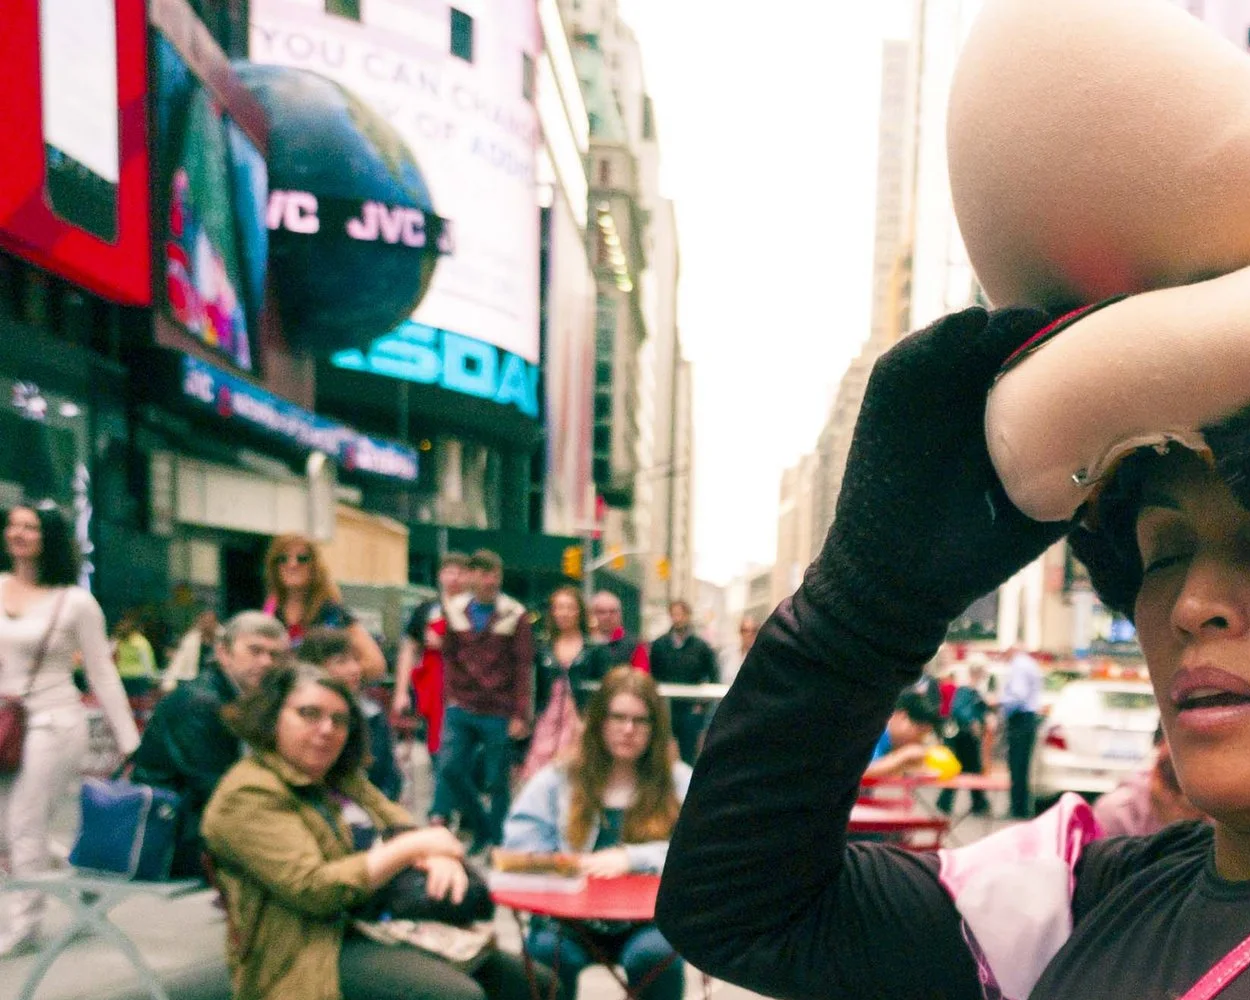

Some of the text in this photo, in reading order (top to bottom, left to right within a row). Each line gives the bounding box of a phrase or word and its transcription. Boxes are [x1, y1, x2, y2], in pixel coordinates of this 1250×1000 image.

[257, 25, 344, 69] YOU
[362, 52, 441, 101] CAN
[345, 200, 427, 249] JVC
